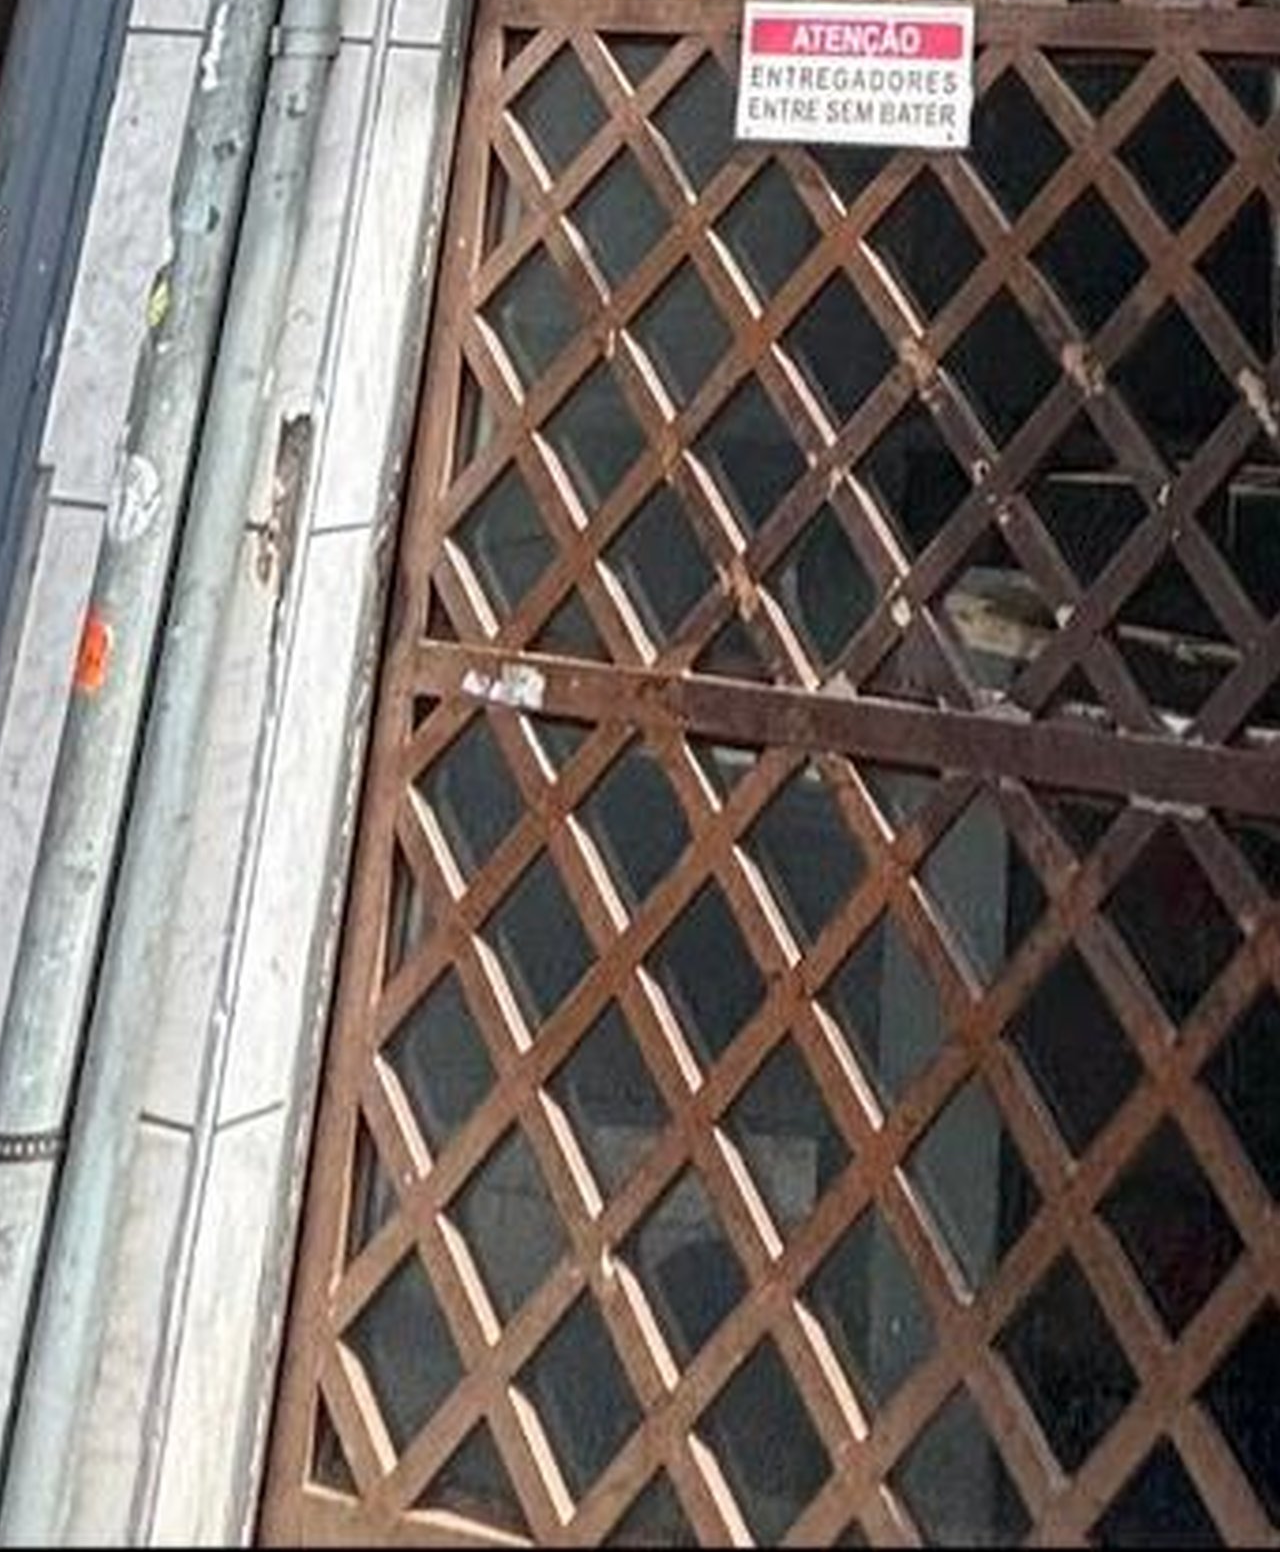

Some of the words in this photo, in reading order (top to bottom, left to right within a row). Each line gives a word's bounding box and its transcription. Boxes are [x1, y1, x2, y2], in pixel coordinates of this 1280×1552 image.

[792, 20, 922, 56] ATENÇÃO
[750, 64, 958, 95] ENTREGADORES
[747, 96, 820, 123] ENTRE
[826, 99, 874, 124] SEM
[879, 102, 957, 128] BATER
